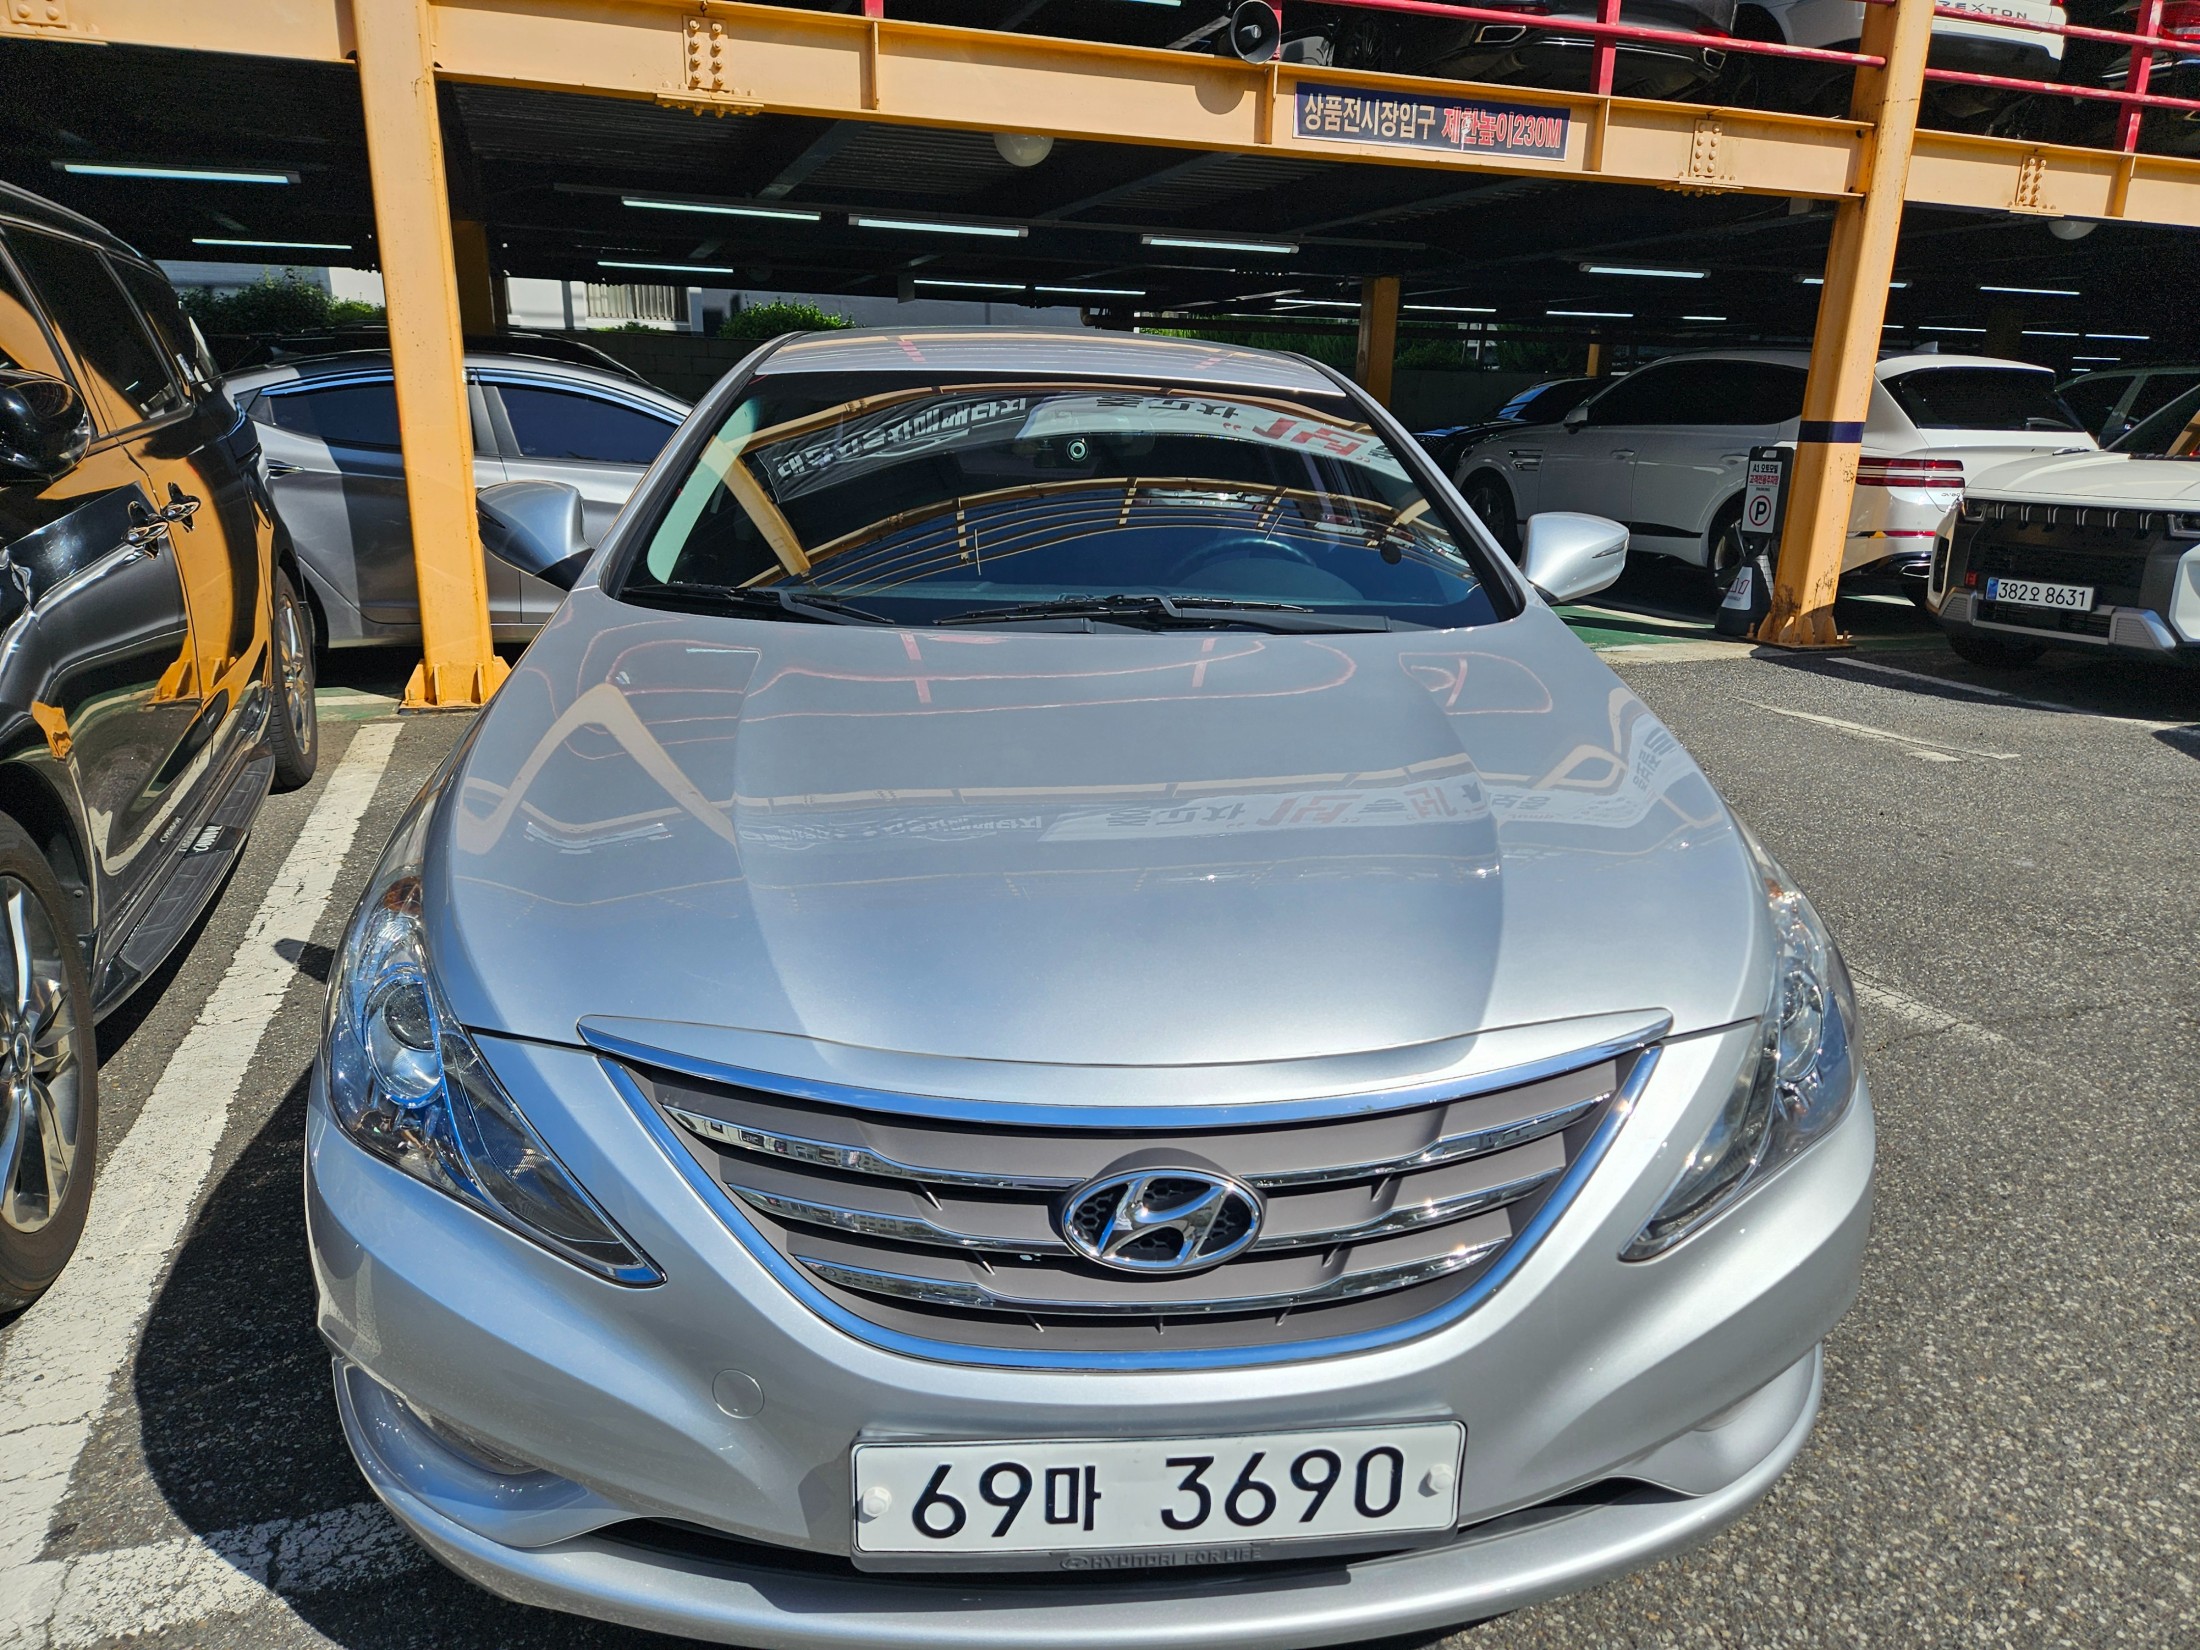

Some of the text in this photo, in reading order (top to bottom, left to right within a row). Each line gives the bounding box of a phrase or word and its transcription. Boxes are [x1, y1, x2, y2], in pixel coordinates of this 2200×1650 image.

[1938, 0, 2028, 19] REXTON
[1304, 92, 1564, 149] 상품전시장입구 제한높이230M
[1998, 582, 2086, 607] 382오 8631
[911, 1446, 1404, 1539] 69마 3690
[1090, 1547, 1262, 1569] HYUNDAI FOR LIFE
